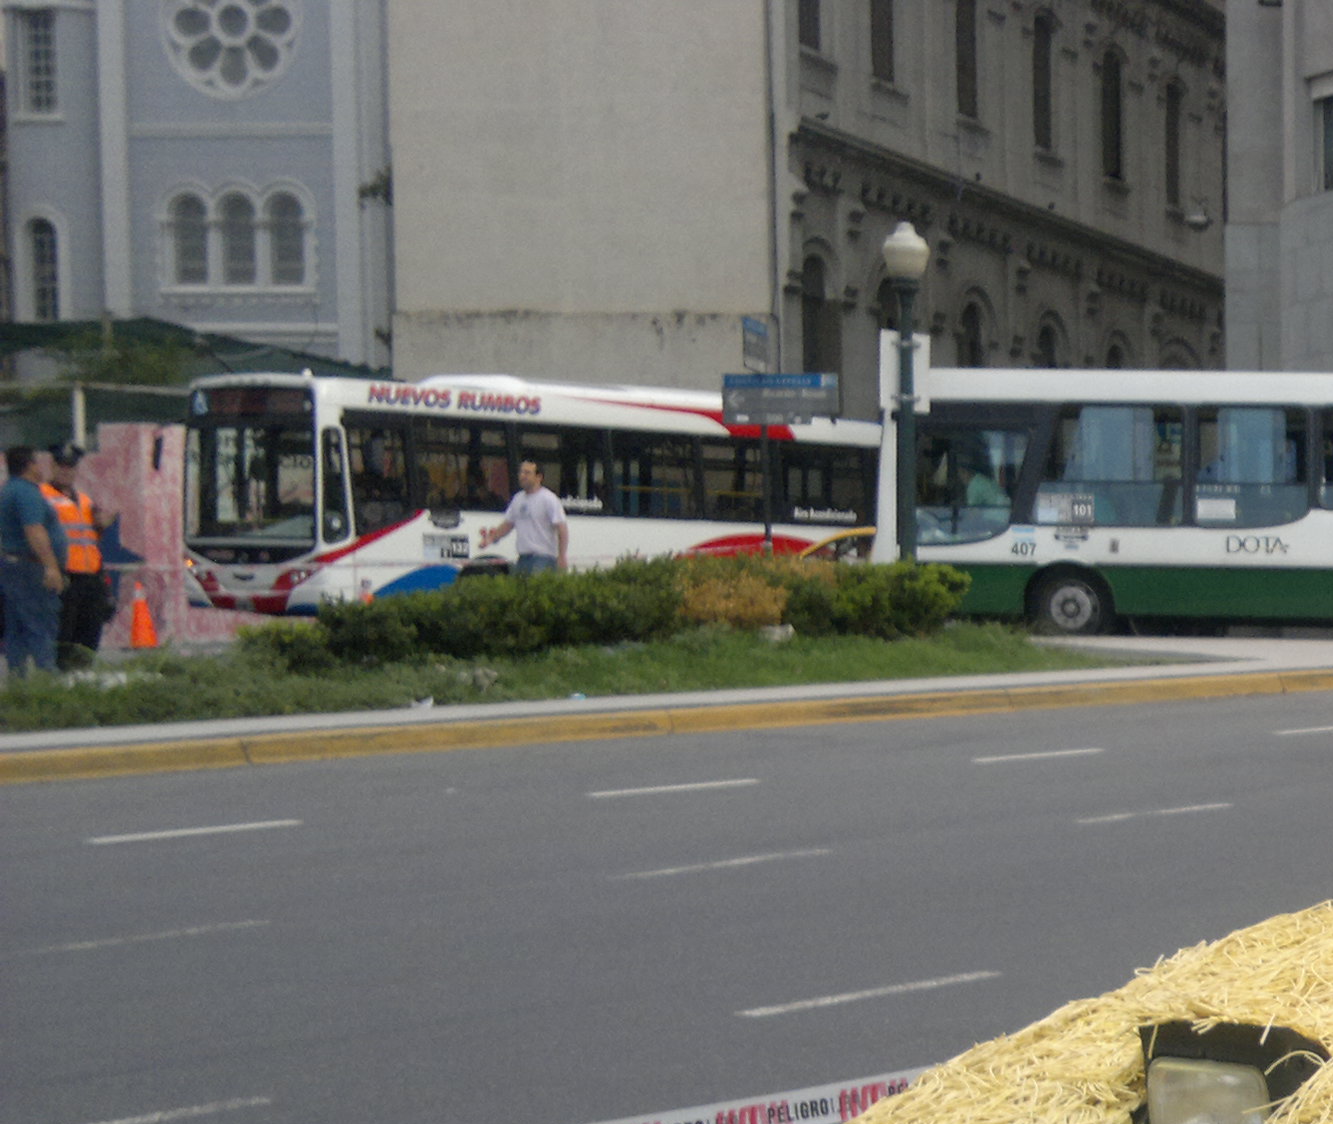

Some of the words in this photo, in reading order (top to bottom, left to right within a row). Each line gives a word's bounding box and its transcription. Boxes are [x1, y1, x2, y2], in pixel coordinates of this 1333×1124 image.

[368, 383, 451, 409] NUEVOS
[457, 390, 542, 415] RUMBOS
[1073, 503, 1092, 516] 101
[1011, 541, 1037, 556] 407
[1226, 535, 1286, 554] DOTA
